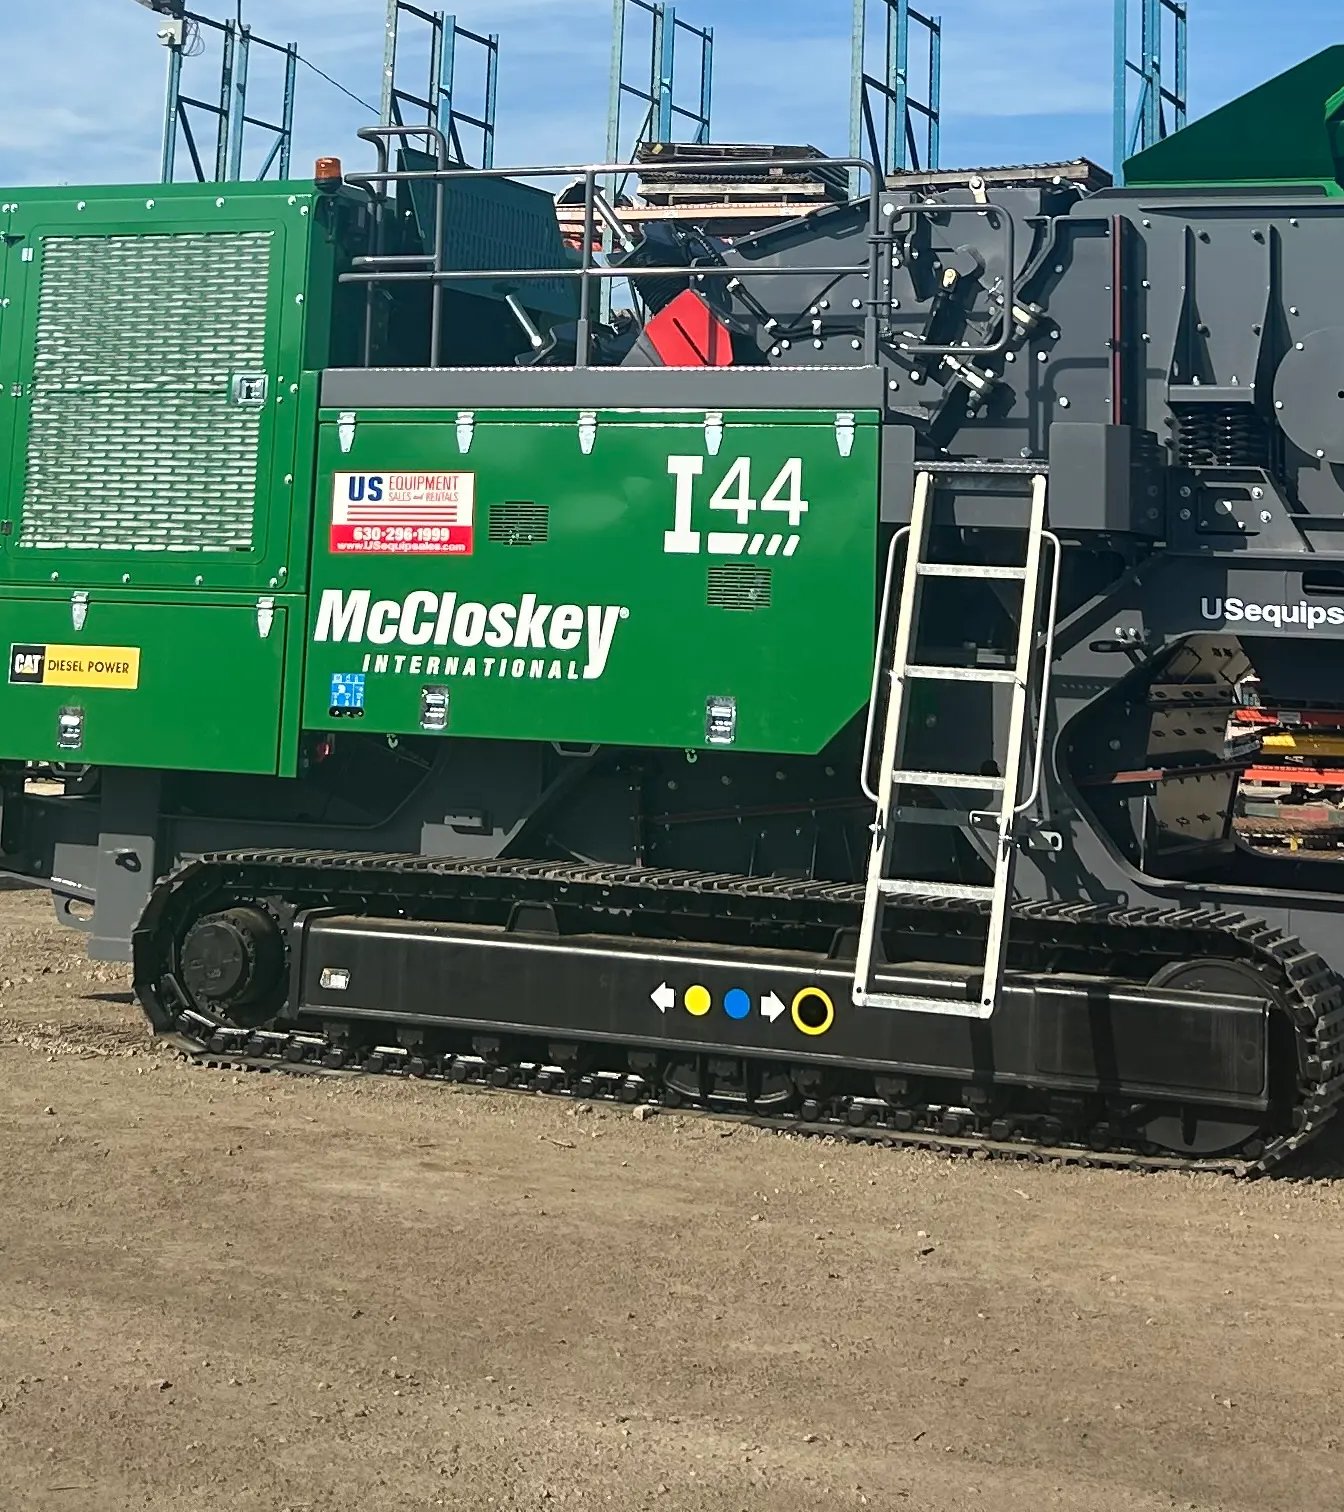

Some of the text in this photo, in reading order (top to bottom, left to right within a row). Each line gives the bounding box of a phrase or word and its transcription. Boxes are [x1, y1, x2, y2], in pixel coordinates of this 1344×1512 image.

[348, 475, 459, 502] US EQUIPMENT
[388, 492, 411, 502] SALES
[425, 492, 459, 502] RENTALS
[313, 589, 621, 680] McCloskey
[14, 653, 130, 674] CAT DIESEL POWER
[362, 653, 578, 679] INTERNATIONAL
